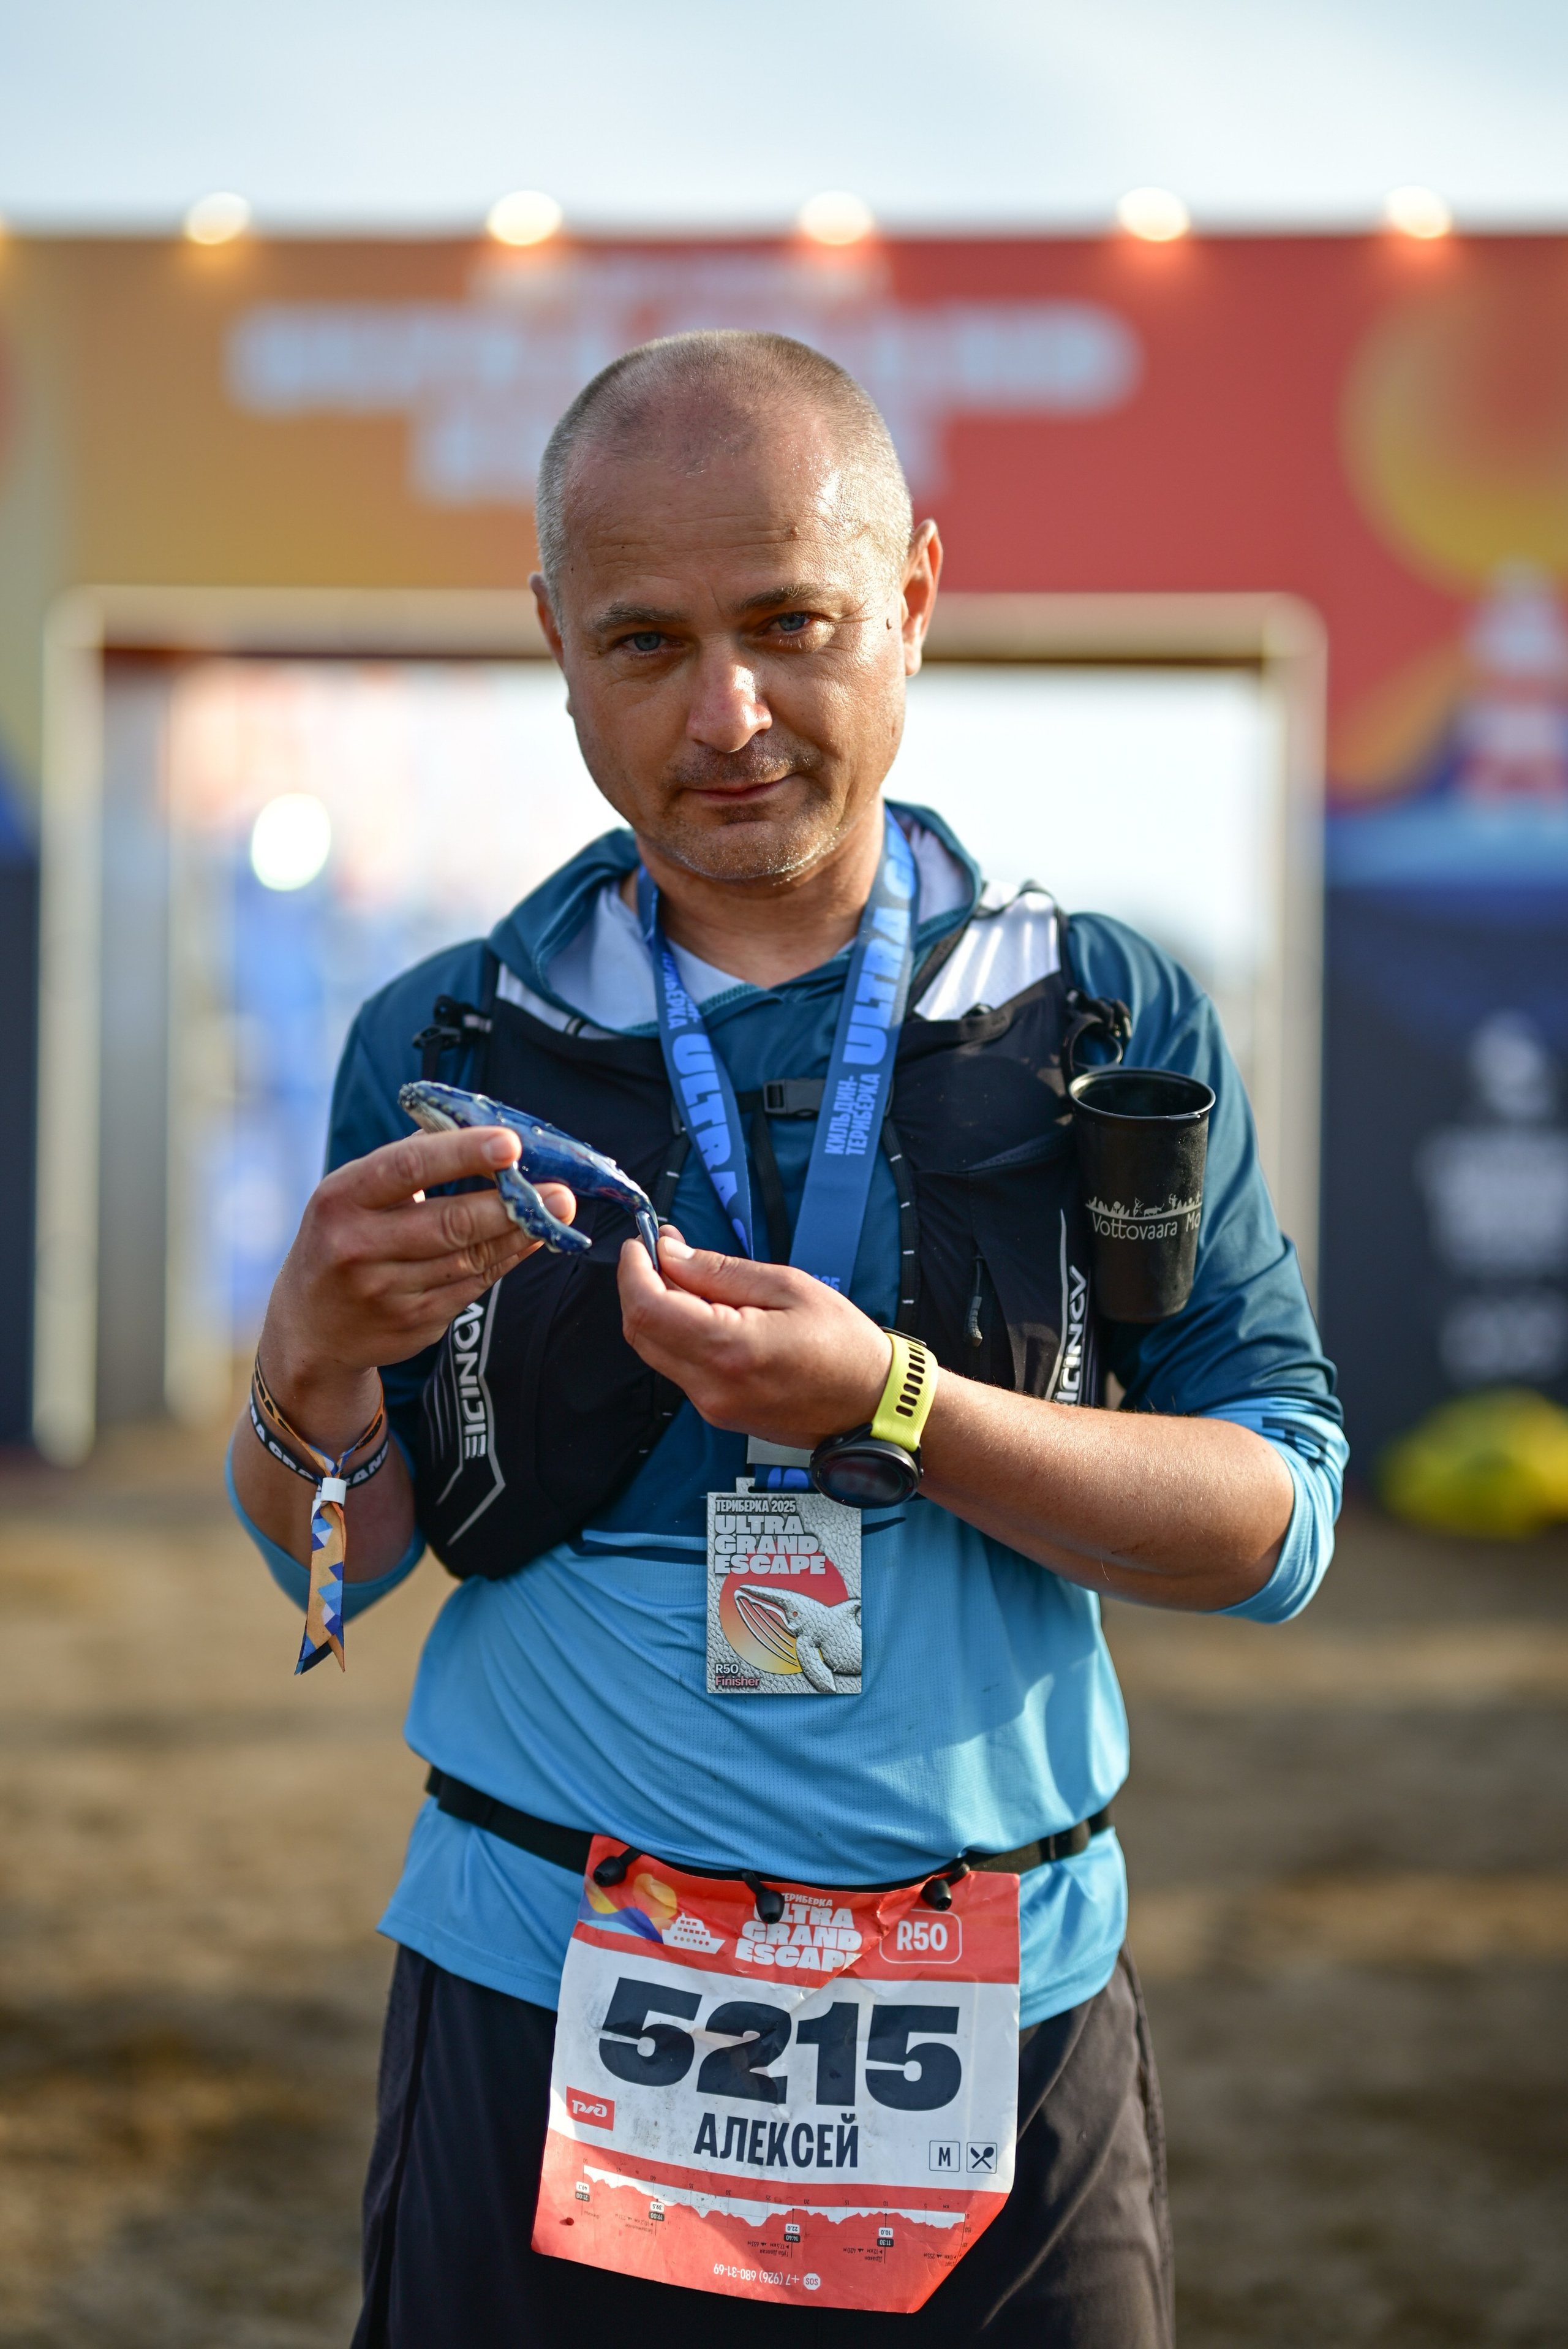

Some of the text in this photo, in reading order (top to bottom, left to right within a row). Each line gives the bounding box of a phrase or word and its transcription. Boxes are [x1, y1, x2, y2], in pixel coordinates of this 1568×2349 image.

[843, 906, 911, 1066] ULTRA
[673, 1033, 737, 1211] ULTRA
[824, 1074, 855, 1155] КИЛЬДИН-
[845, 1073, 881, 1156] ТЕРИБЕРКА
[1092, 1211, 1178, 1241] Vottovaara
[1057, 1265, 1087, 1407] AONIJI
[715, 1499, 796, 1513] ТЕРИБЕРКА 2025
[715, 1515, 804, 1535] ULTRA
[714, 1535, 819, 1555] GRAND
[715, 1555, 826, 1575] ESCAPE
[715, 1664, 739, 1674] R50
[715, 1676, 760, 1687] Finisher
[754, 1902, 855, 1929] LTRA
[742, 1921, 862, 1951] GRAND
[897, 1920, 948, 1951] R50
[598, 1977, 962, 2111] 5215
[693, 2113, 859, 2168] АЛЕКСЕЙ
[714, 2263, 756, 2282] 680-31-69
[759, 2270, 783, 2285] (926)
[785, 2274, 800, 2286] +7
